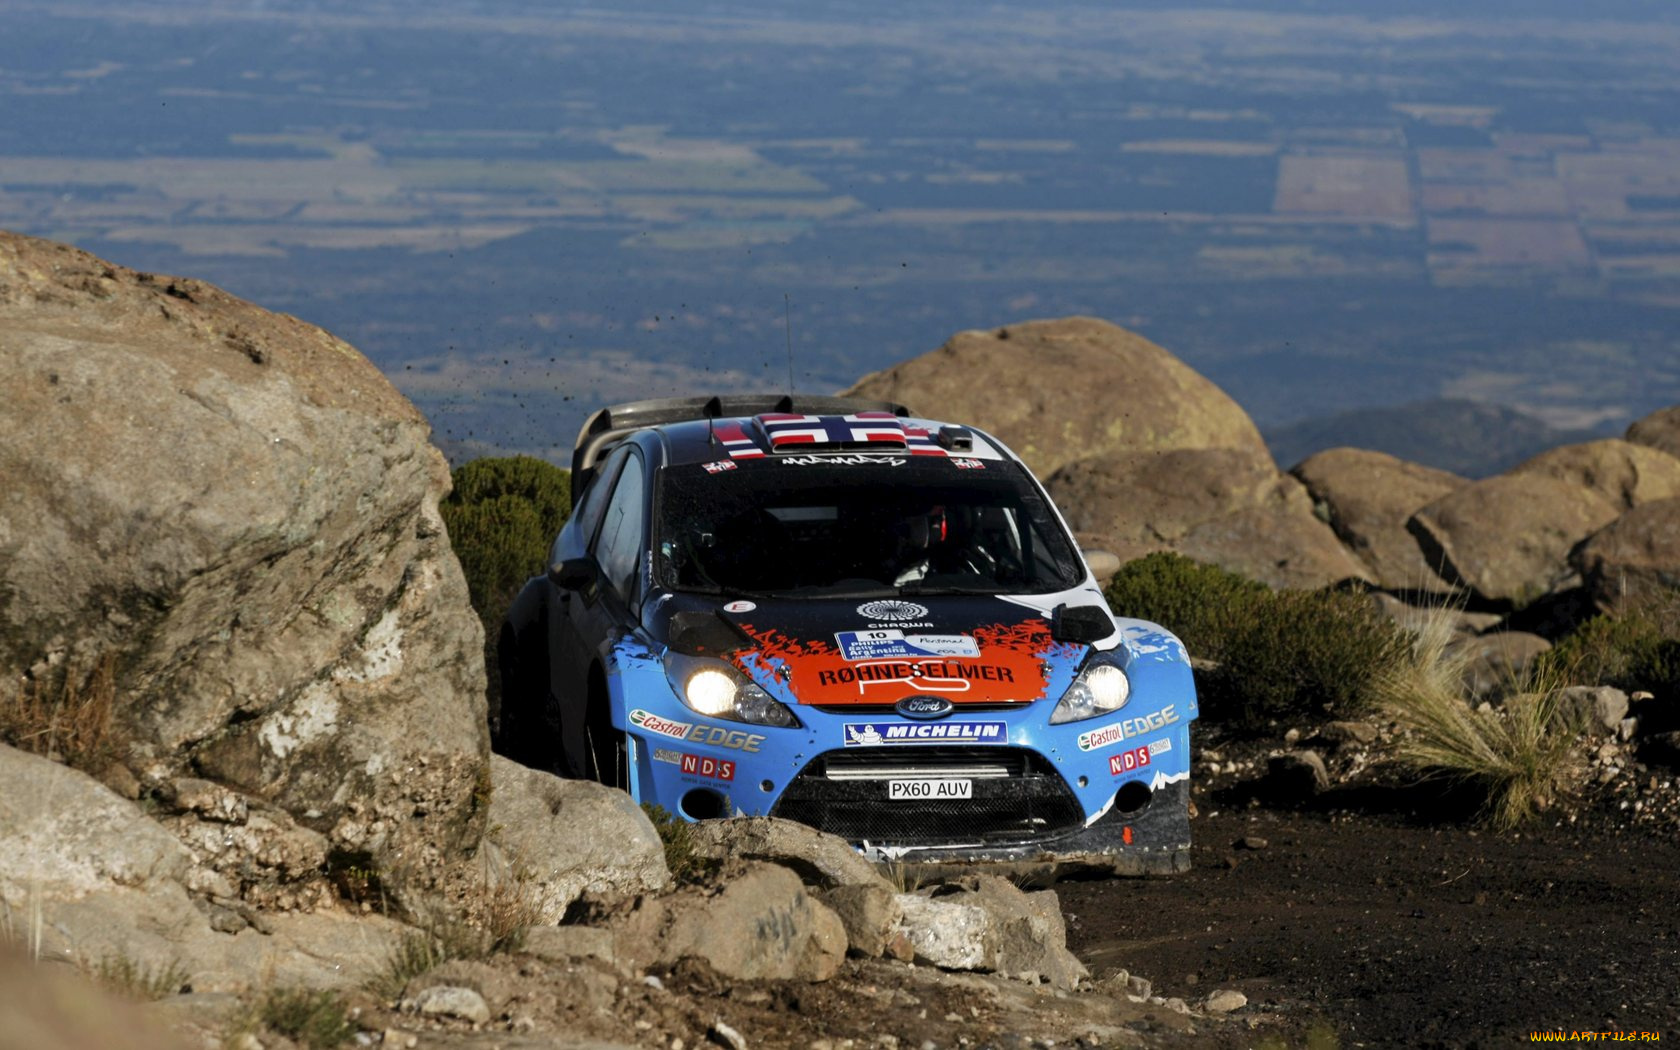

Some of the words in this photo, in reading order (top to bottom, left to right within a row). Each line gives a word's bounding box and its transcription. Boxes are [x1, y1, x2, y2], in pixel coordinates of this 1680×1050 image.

[867, 631, 887, 640] 10
[850, 639, 894, 647] PHILIPS
[850, 647, 906, 657] Argentina
[908, 701, 940, 711] Ford
[1090, 726, 1121, 747] Castrol
[1122, 704, 1180, 738] EDGE
[643, 716, 689, 738] Castrol
[687, 724, 766, 753] EDGE
[886, 725, 1000, 738] MICHELIN
[892, 782, 931, 796] PX60
[936, 782, 969, 796] AUV
